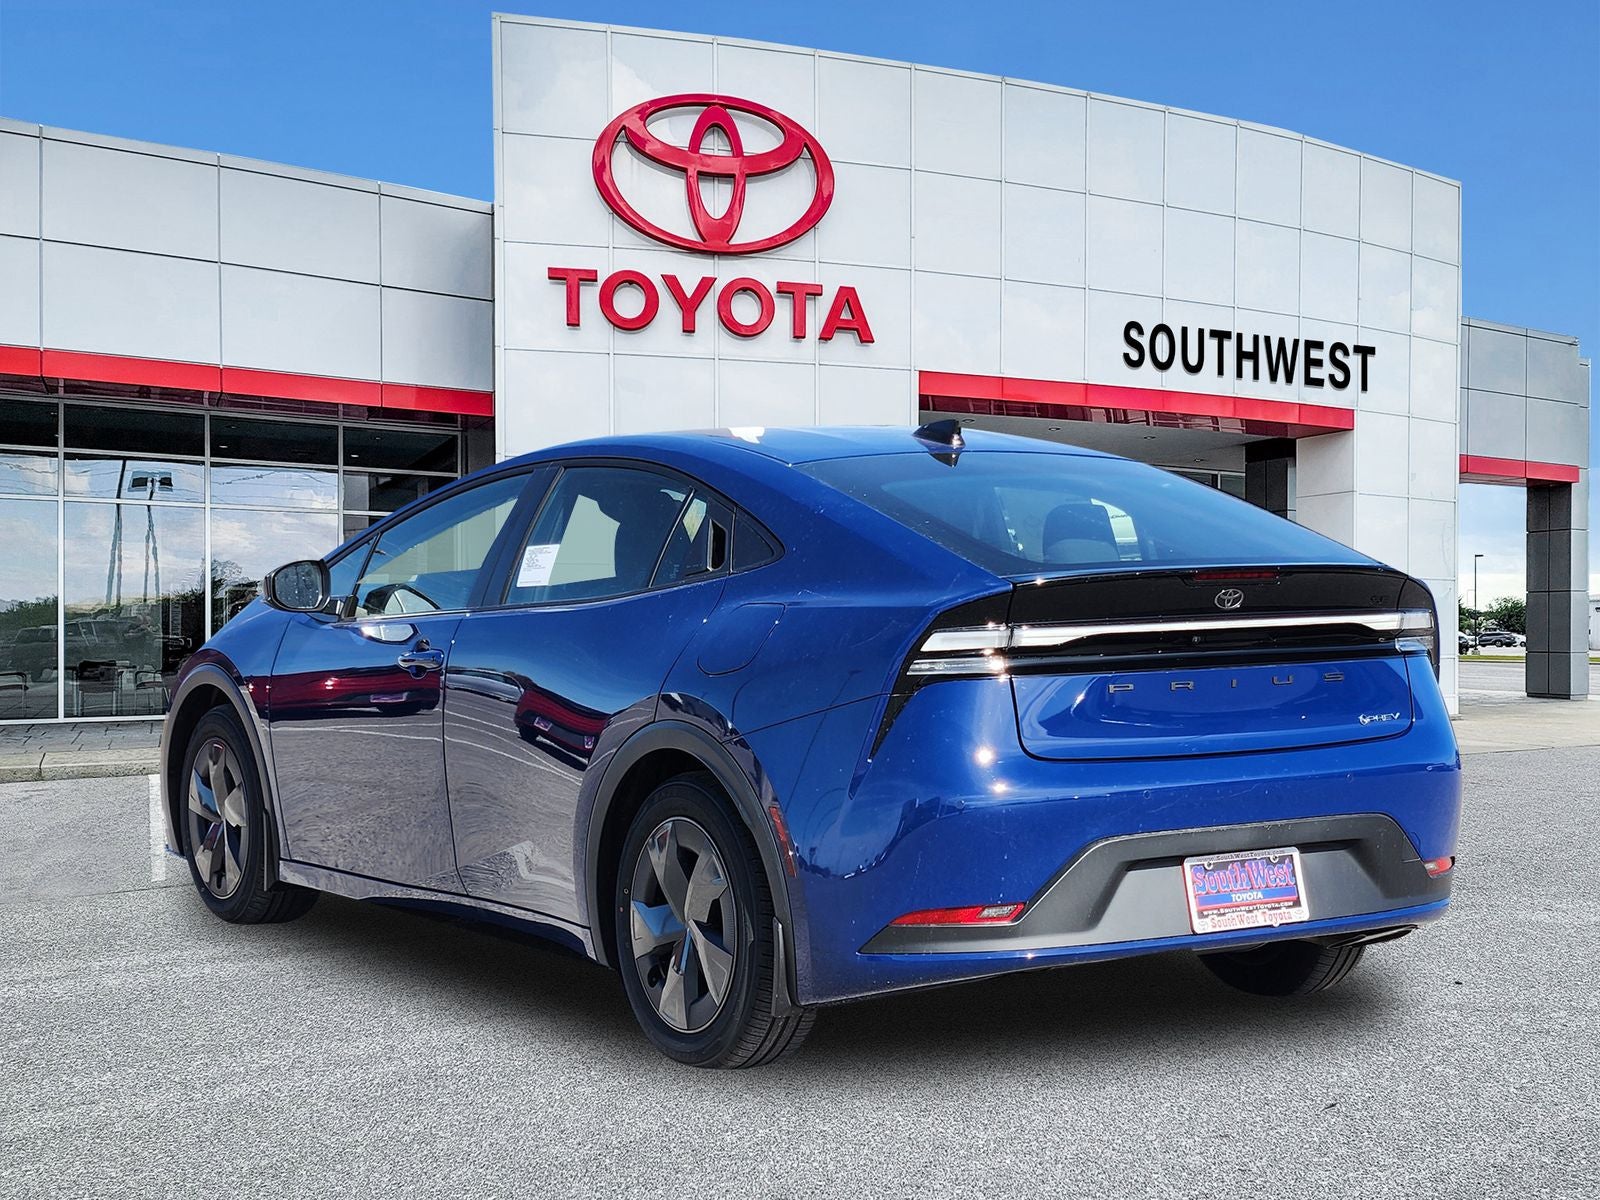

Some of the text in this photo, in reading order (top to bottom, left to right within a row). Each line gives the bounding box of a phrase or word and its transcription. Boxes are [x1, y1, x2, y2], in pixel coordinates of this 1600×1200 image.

[548, 266, 875, 344] TOYOTA
[1122, 320, 1376, 394] SOUTHWEST
[1108, 671, 1345, 694] PRIUS
[1230, 891, 1264, 902] TOYOTA
[1262, 911, 1293, 925] Toyota
